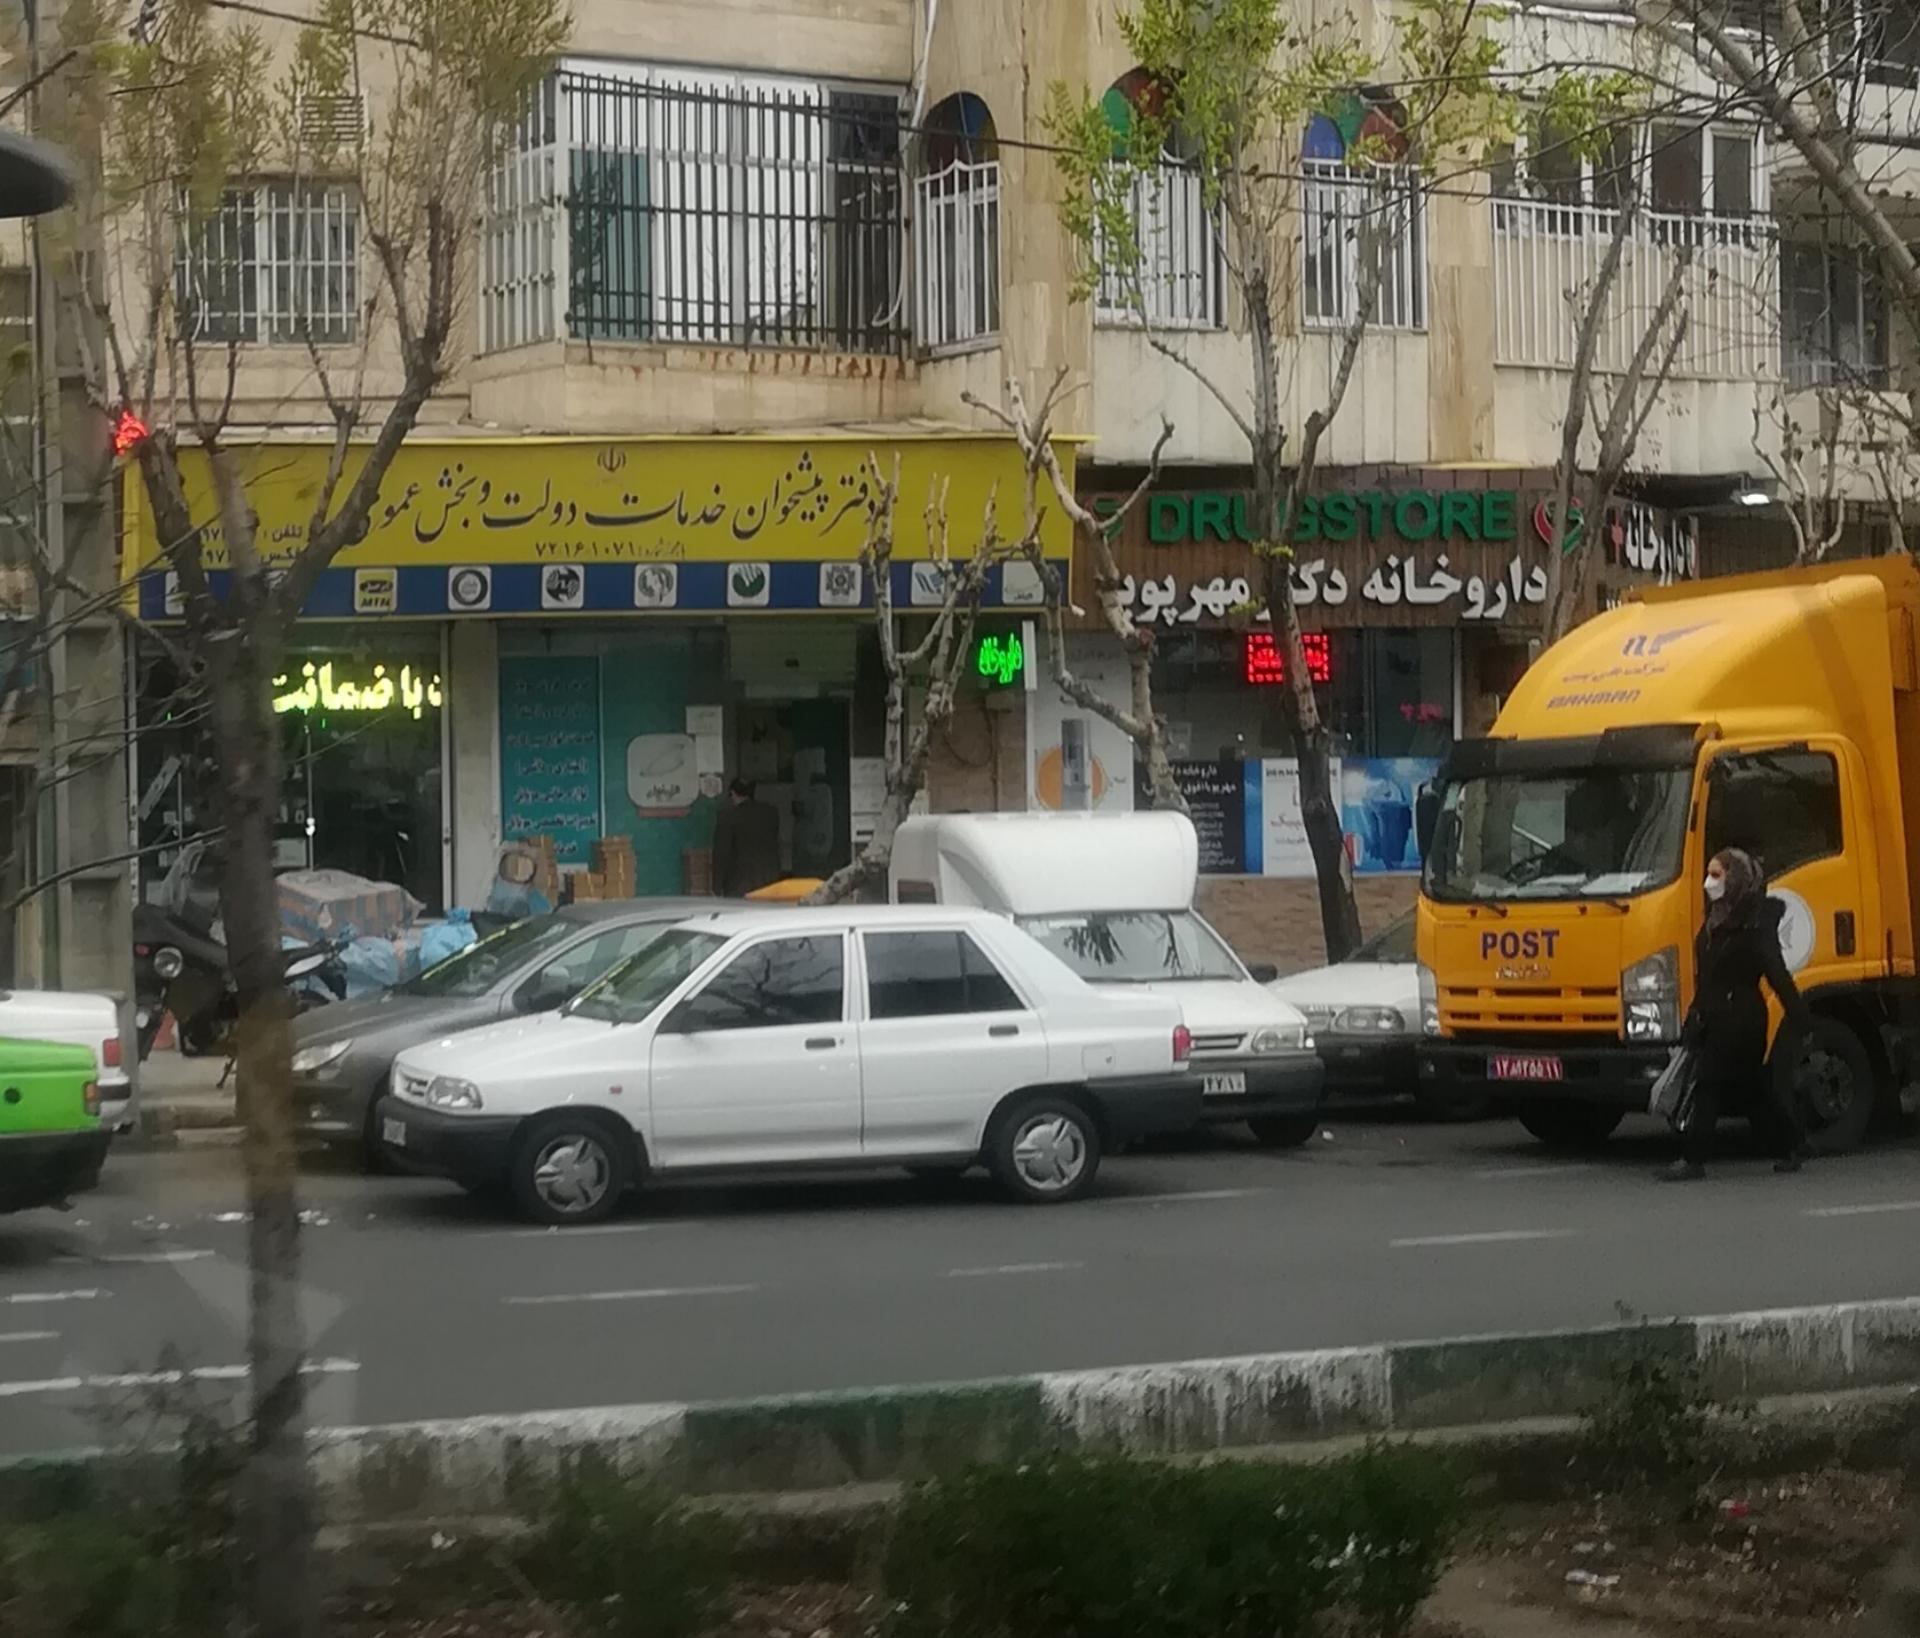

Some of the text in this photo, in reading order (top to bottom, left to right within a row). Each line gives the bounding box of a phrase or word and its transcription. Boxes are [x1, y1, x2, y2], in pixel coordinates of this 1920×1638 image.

[379, 482, 421, 529] عمو
[415, 462, 478, 543] بخش
[482, 478, 577, 529] دولت
[584, 483, 727, 527] خدمات
[732, 450, 828, 540] پیشخوان
[1150, 490, 1519, 544] DRUGSTORE
[1362, 553, 1548, 619] داروخانه
[272, 661, 394, 713] ضمانت
[401, 655, 423, 720] با
[1481, 929, 1561, 960] POST
